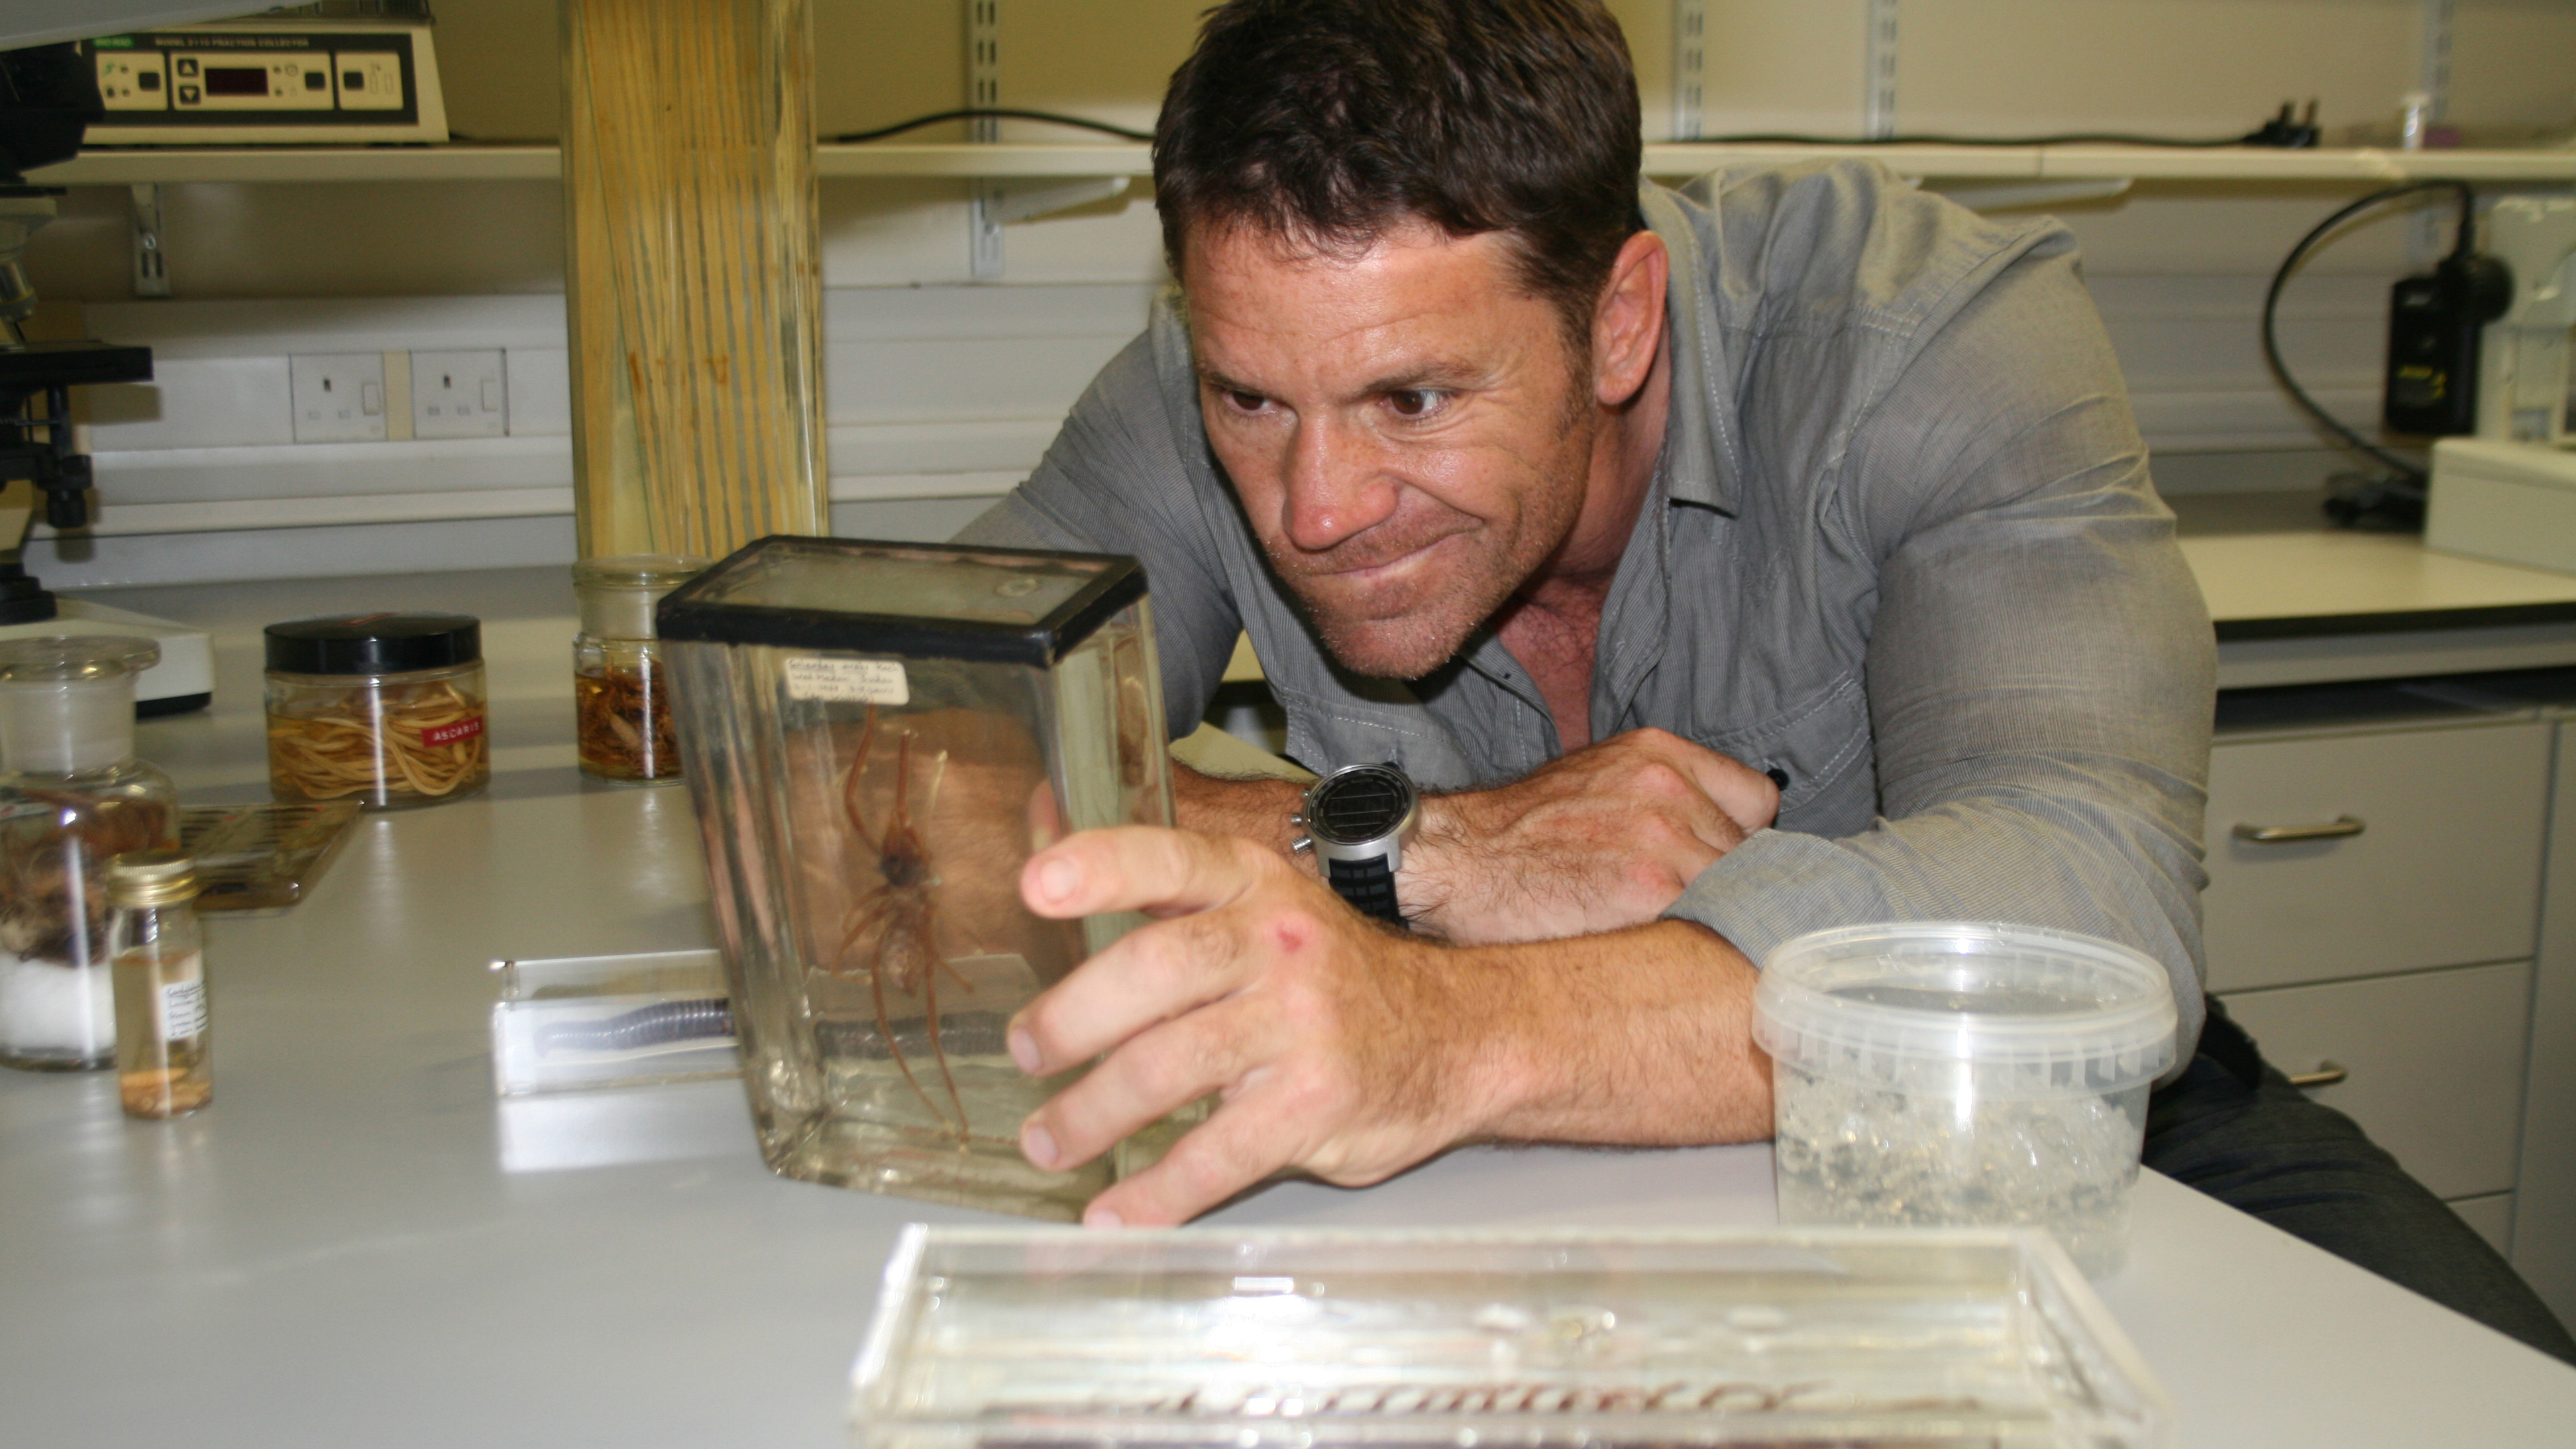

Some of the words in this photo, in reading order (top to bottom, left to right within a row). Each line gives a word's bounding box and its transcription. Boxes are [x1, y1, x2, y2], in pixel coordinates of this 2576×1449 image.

[155, 38, 185, 47] MODEL
[211, 38, 256, 47] FRACTION
[258, 38, 309, 47] COLLECTOR
[433, 721, 480, 741] ASCARIS
